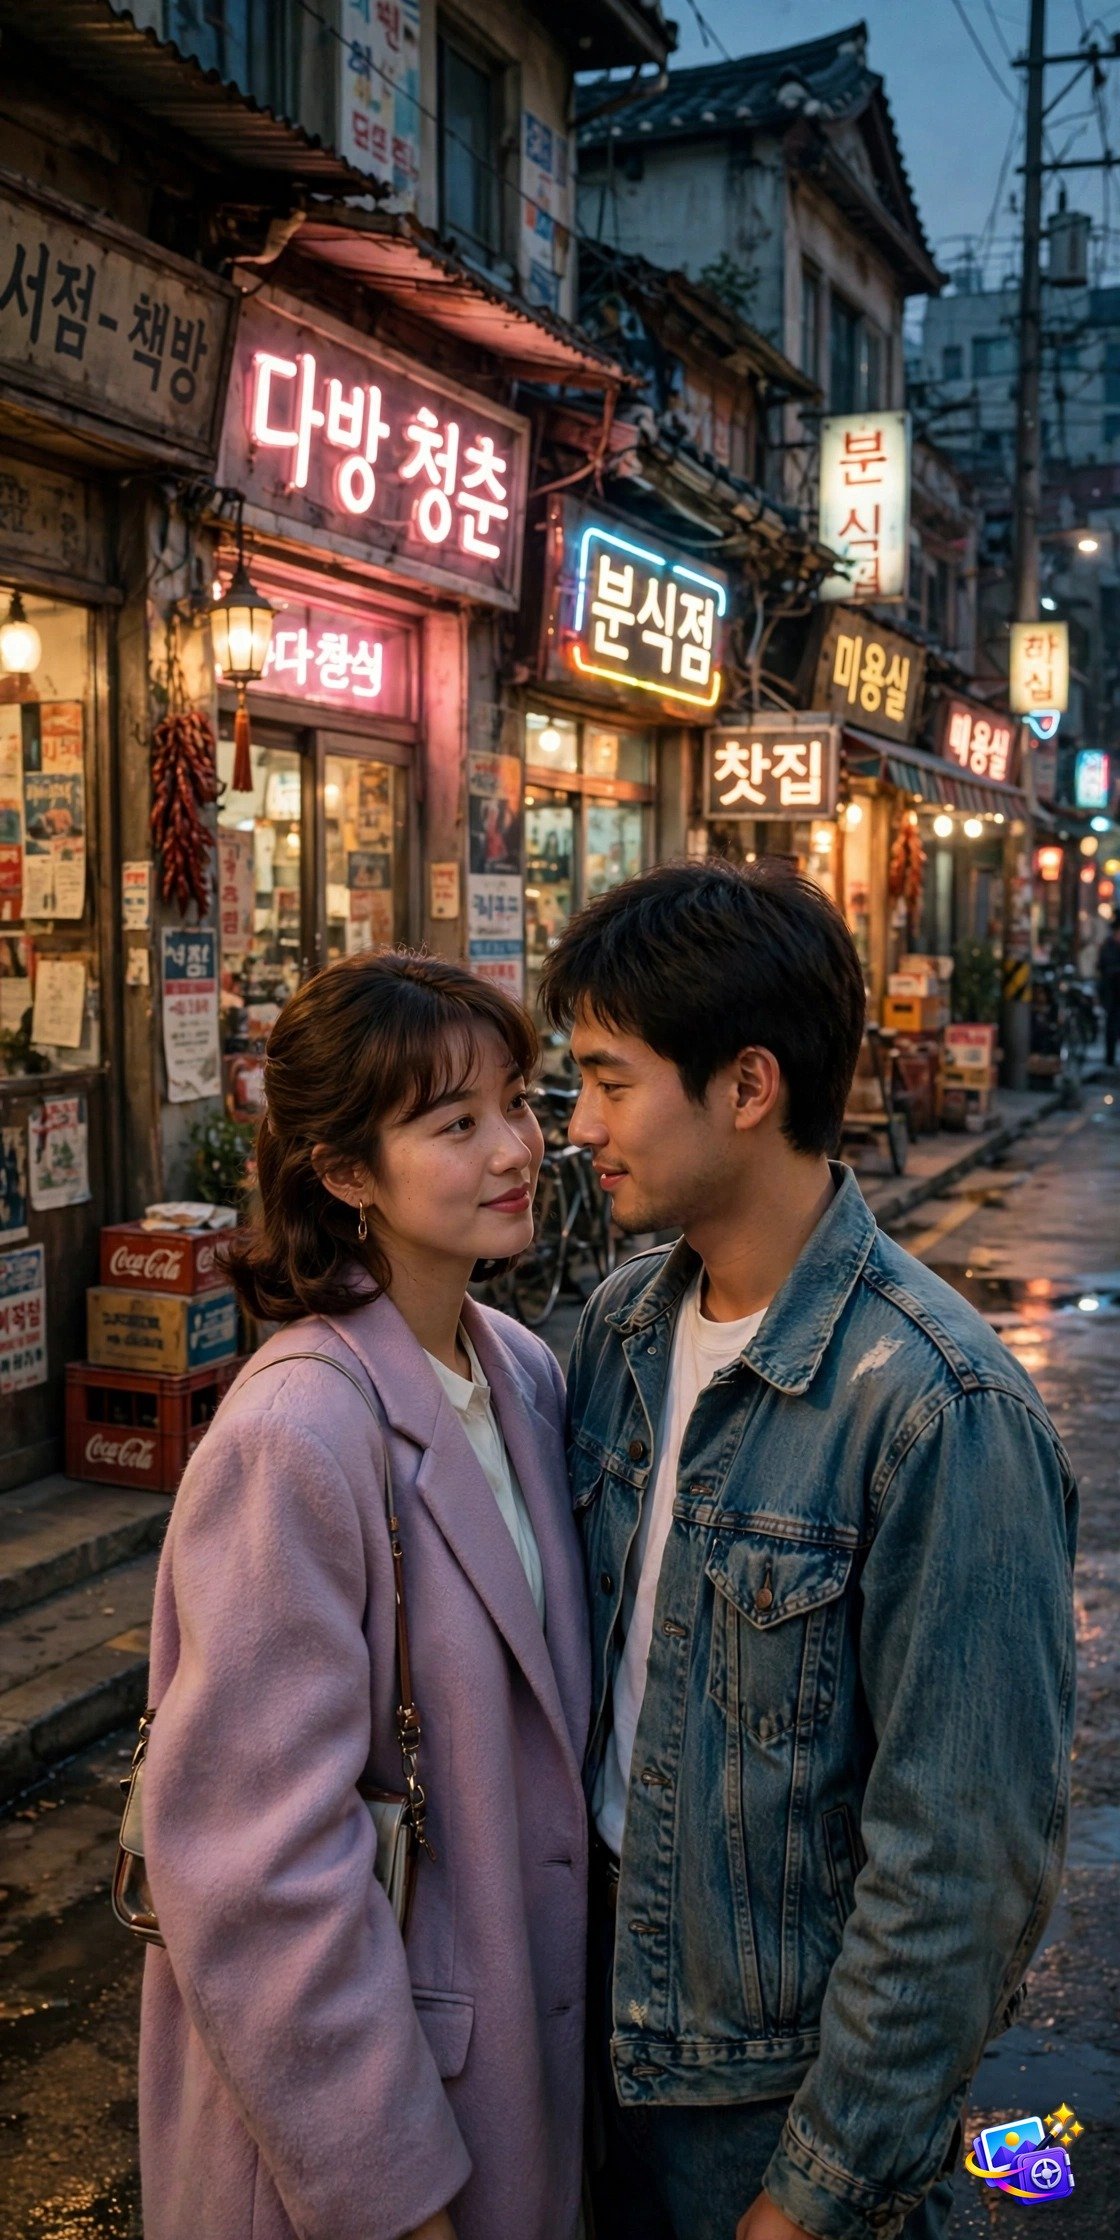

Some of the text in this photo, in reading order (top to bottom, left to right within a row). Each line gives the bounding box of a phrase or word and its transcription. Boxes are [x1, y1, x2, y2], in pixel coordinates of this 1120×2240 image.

[253, 352, 390, 514] 다방
[399, 406, 509, 559] 청춘
[591, 554, 714, 685] 분식점
[833, 634, 910, 722] 미용실
[714, 740, 822, 806] 찻집
[949, 712, 1010, 781] 미용실
